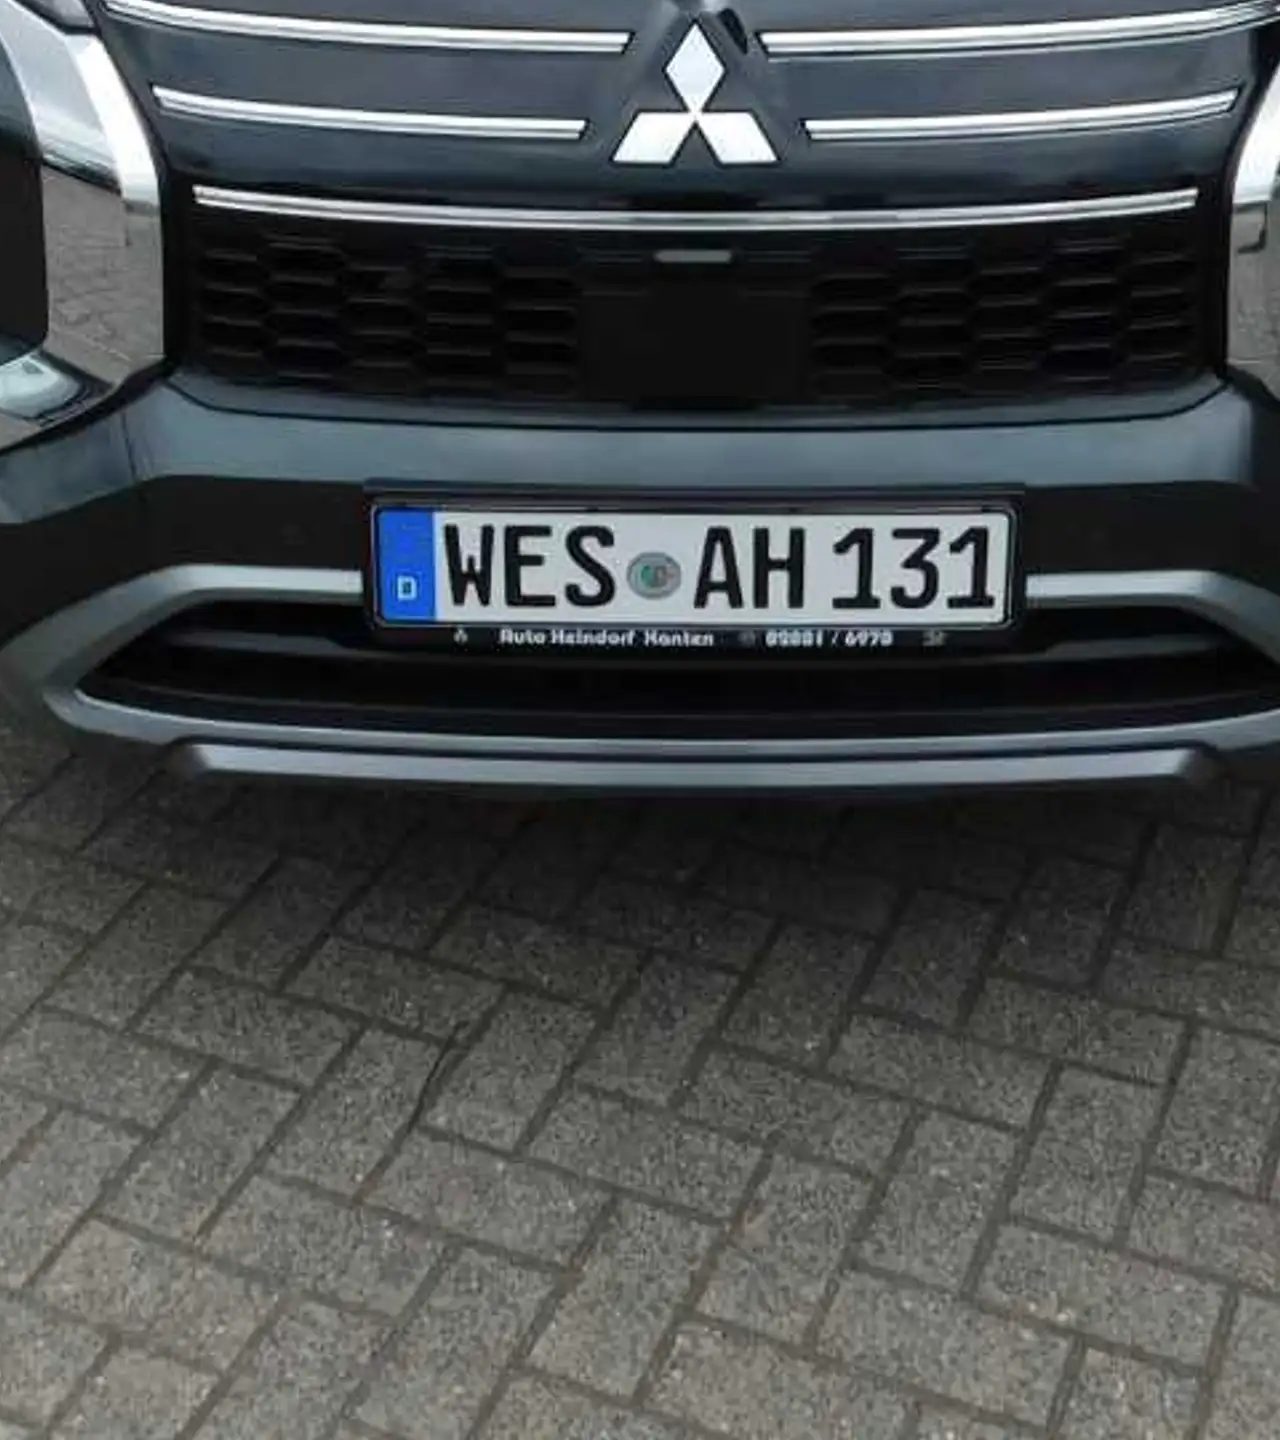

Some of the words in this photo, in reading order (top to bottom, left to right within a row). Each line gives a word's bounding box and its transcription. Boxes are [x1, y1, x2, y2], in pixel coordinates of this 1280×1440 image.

[444, 523, 616, 609] WES
[693, 526, 805, 610] AH
[832, 526, 997, 610] 131
[397, 577, 417, 601] D
[498, 627, 546, 645] Auto
